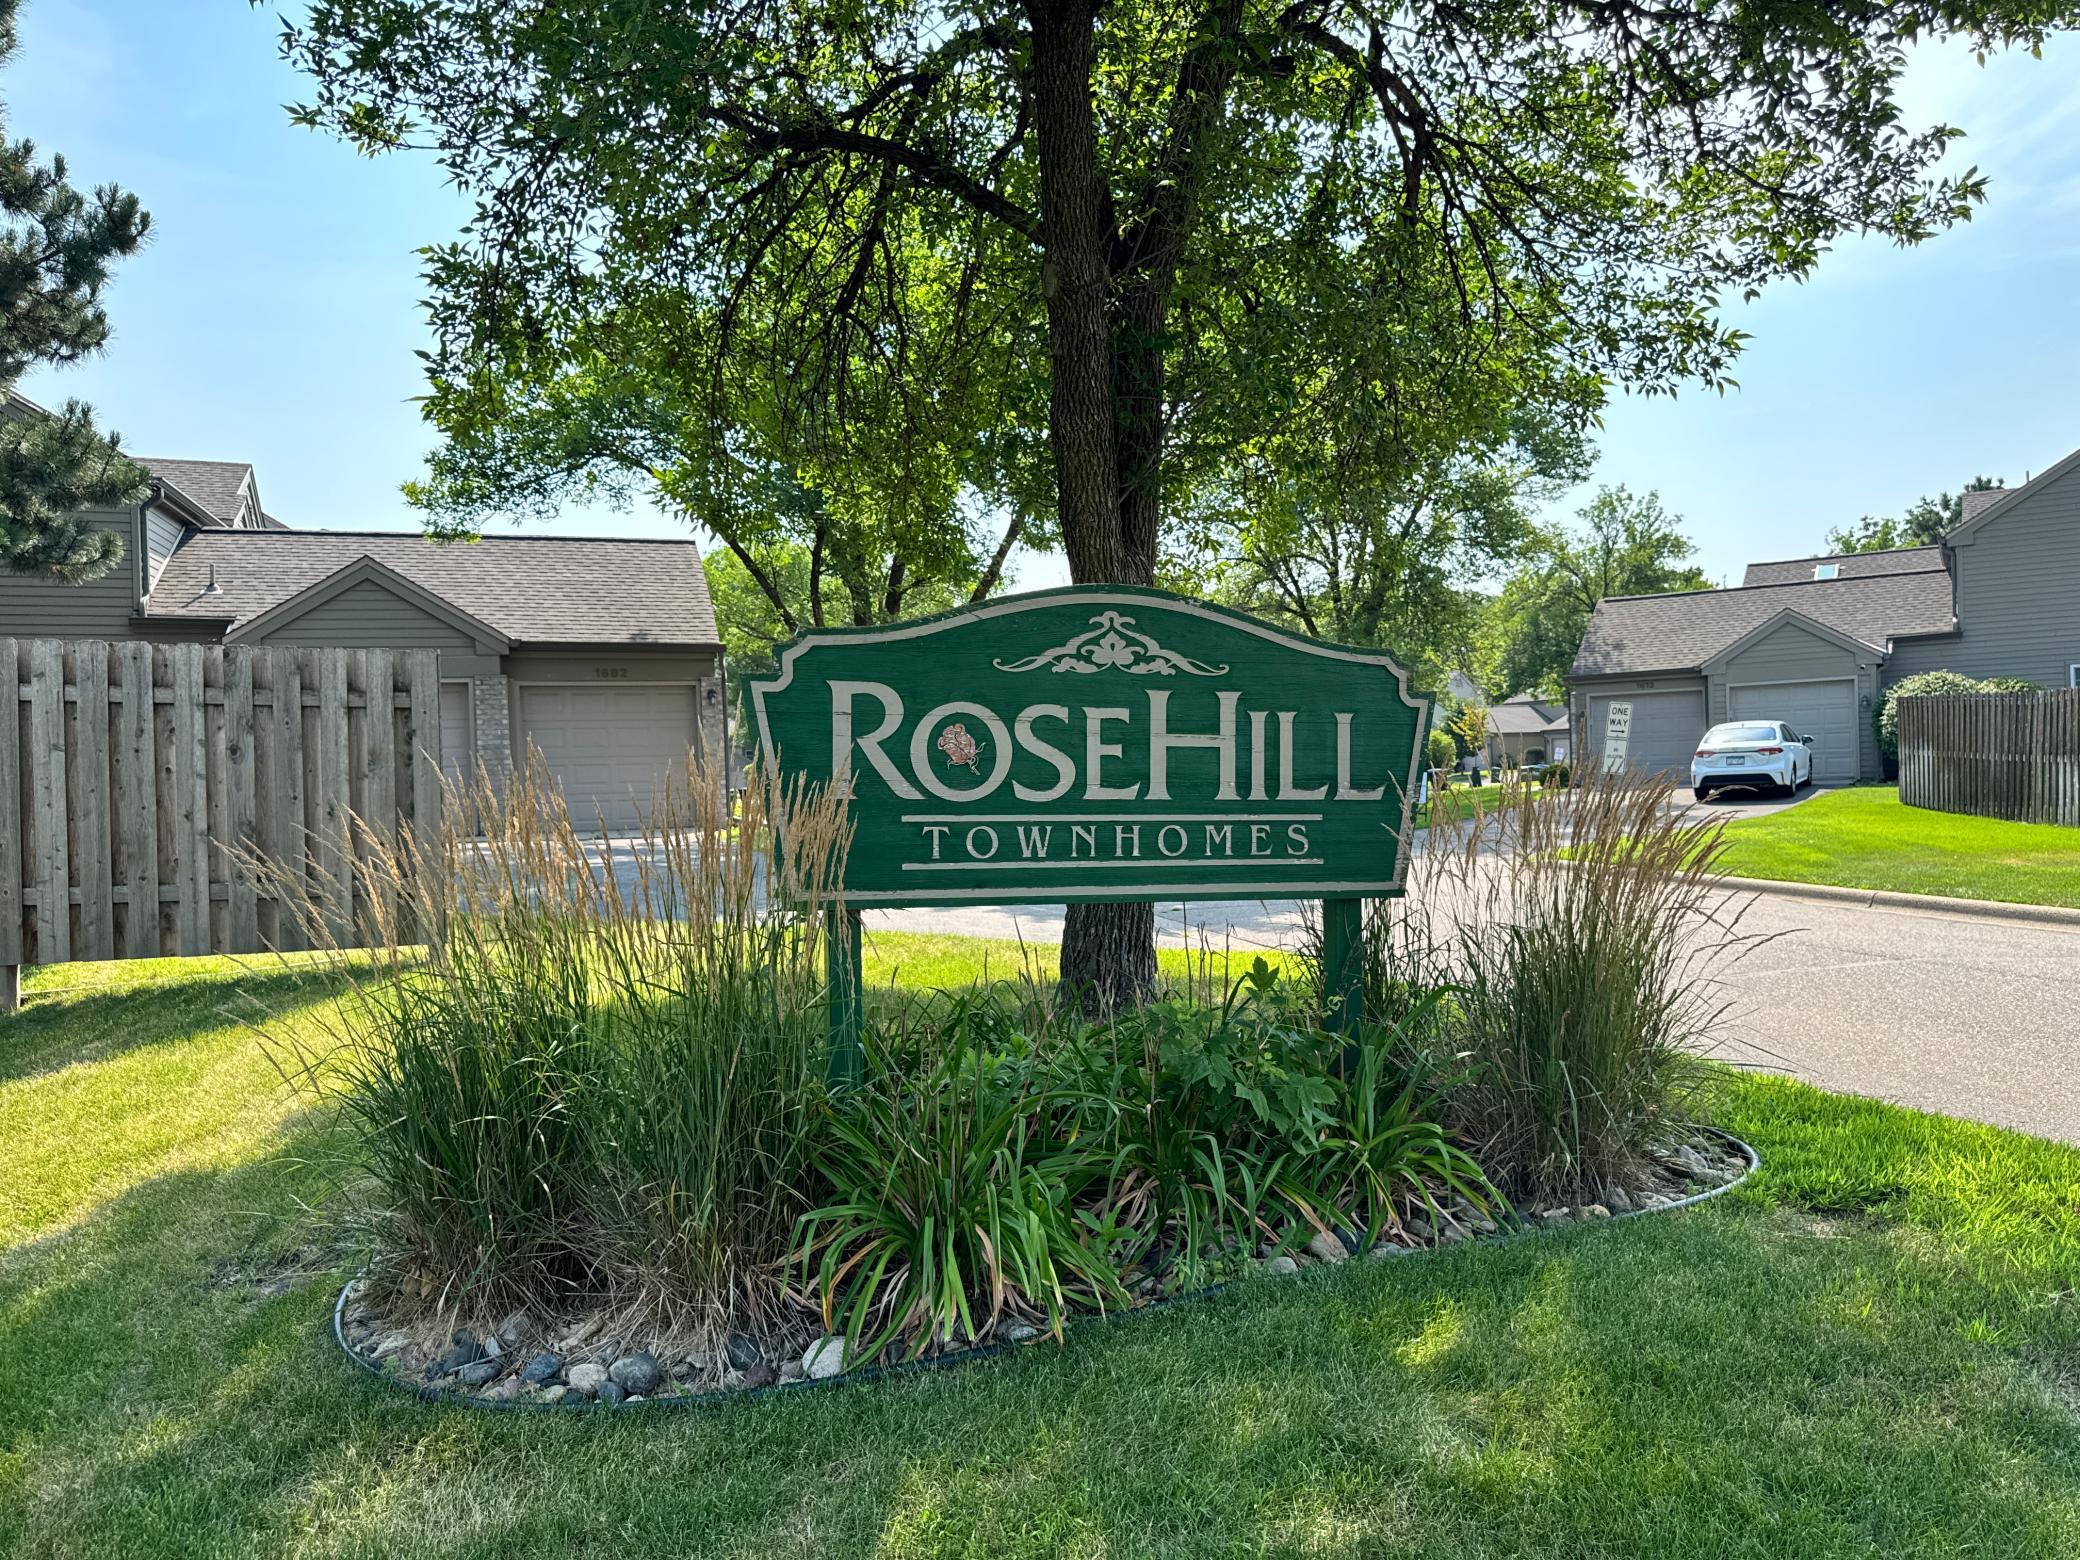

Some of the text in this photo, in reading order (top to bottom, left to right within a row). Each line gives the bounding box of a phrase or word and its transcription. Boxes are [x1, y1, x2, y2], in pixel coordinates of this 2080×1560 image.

[1612, 706, 1629, 716] ONE
[1609, 718, 1629, 727] WAY
[921, 823, 1310, 860] TOWNHOMES
